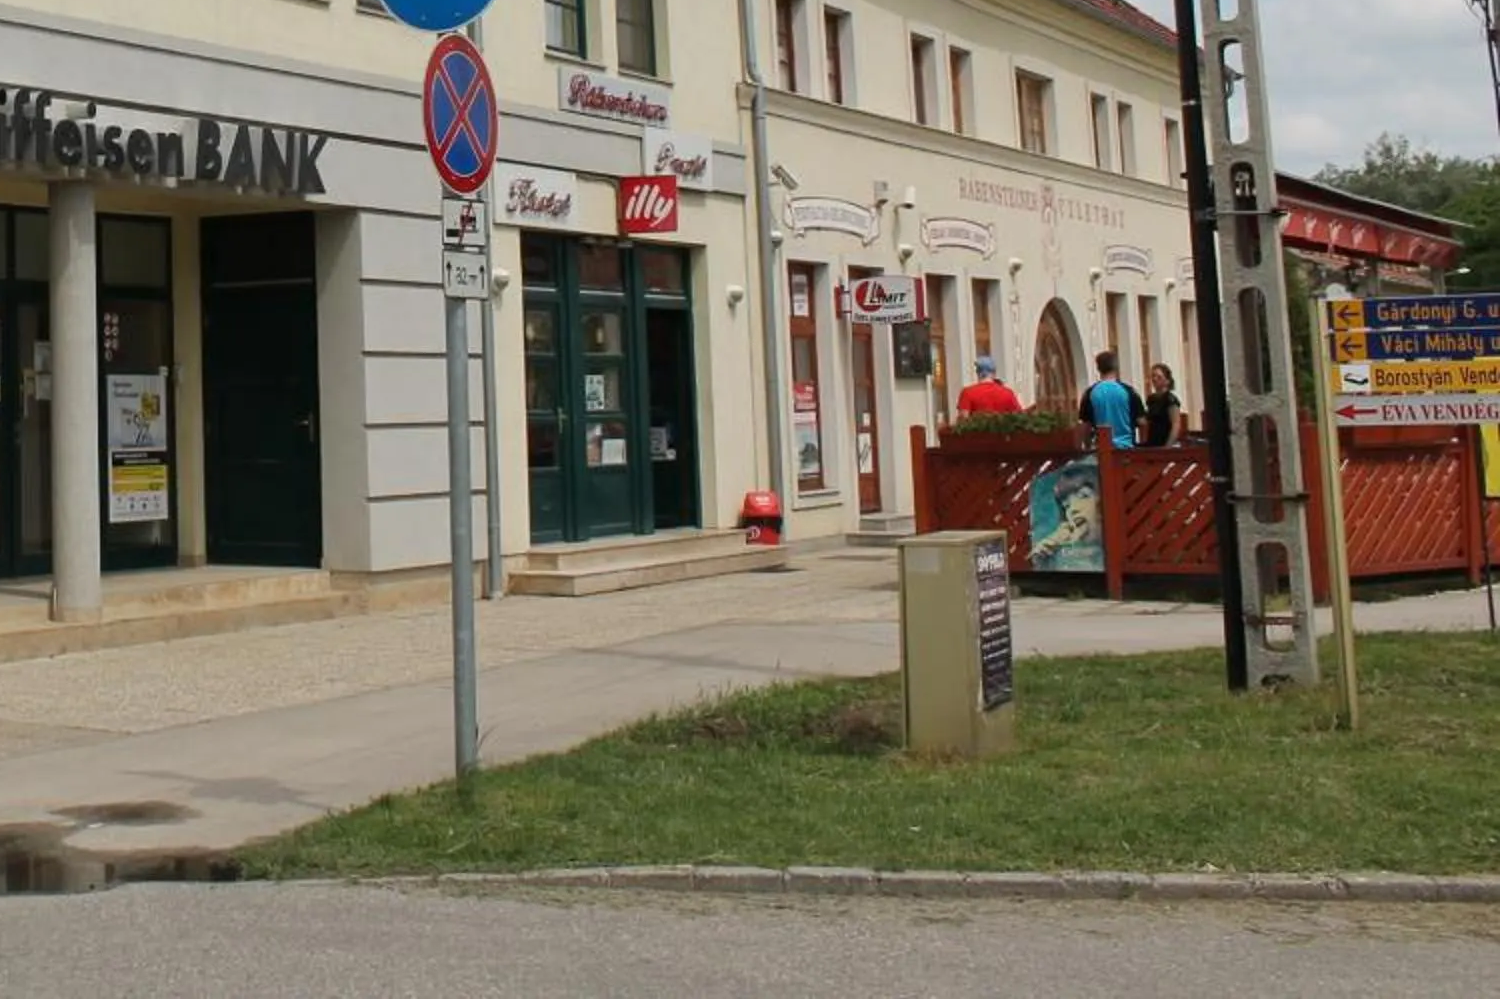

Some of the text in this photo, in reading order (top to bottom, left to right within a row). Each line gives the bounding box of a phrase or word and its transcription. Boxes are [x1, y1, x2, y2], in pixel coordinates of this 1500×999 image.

[196, 118, 331, 195] BANK
[625, 184, 675, 227] illy
[1377, 301, 1457, 324] Gárdonyi
[1463, 300, 1481, 318] G.
[1381, 334, 1419, 353] Váci
[1425, 332, 1484, 355] Mihály
[1375, 365, 1500, 388] Borostyán Vend
[1381, 399, 1417, 421] ÉVA
